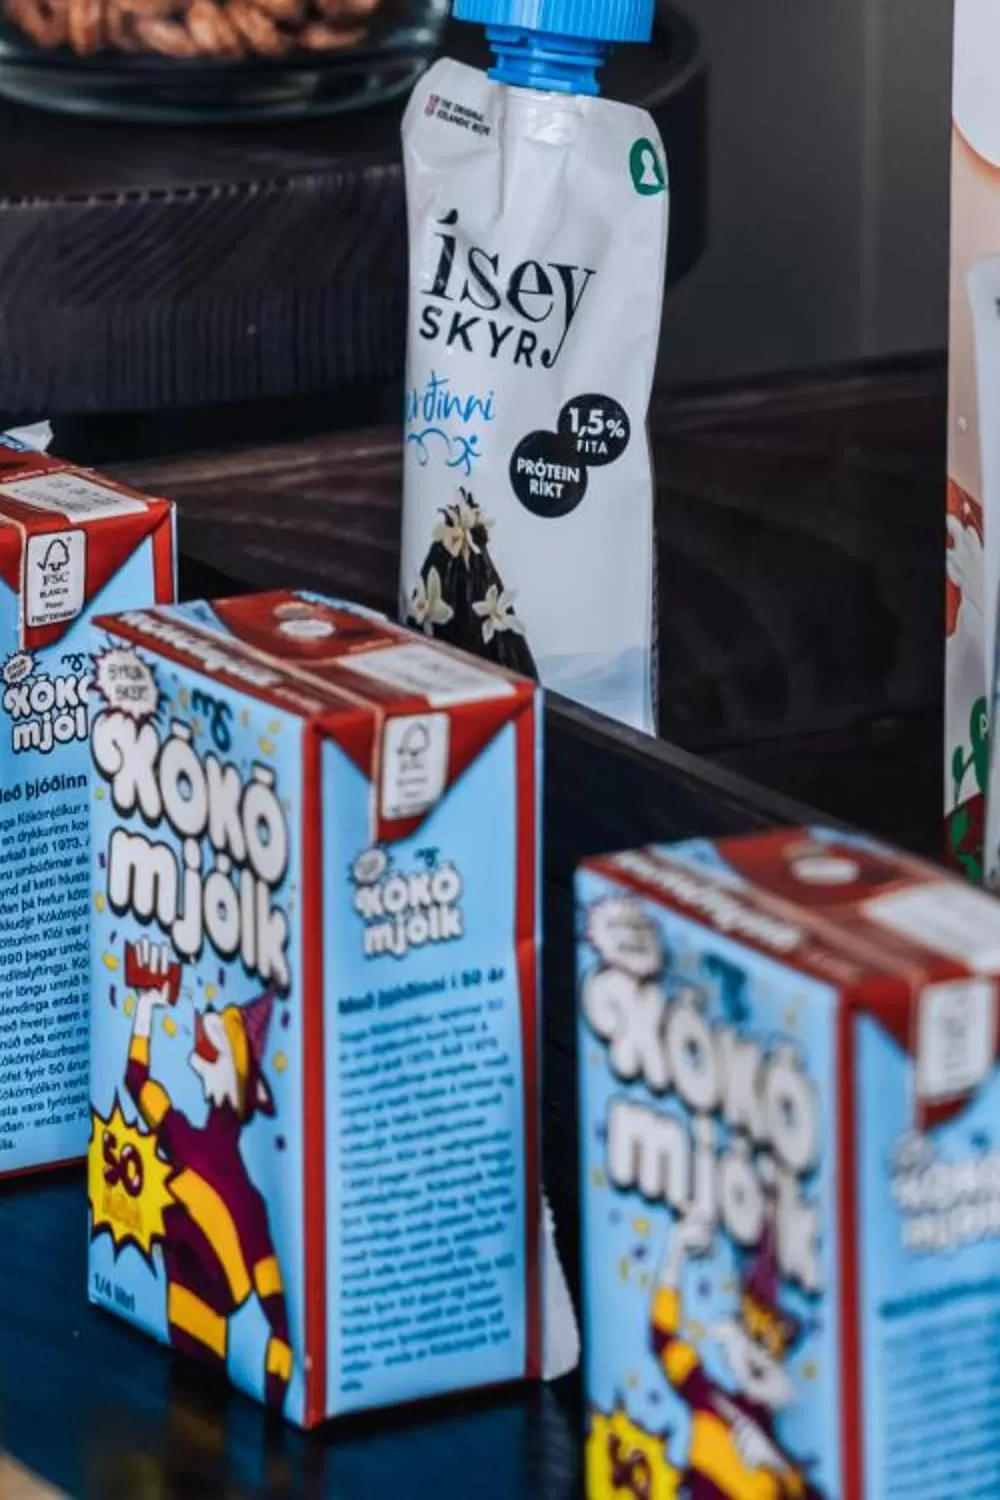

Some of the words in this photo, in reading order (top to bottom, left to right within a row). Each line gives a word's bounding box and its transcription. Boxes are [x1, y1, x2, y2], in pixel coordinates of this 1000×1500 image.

[419, 305, 538, 368] SKYR
[569, 407, 626, 439] 1,5%
[577, 439, 609, 454] FITA
[517, 456, 580, 483] PRÓTEIN
[529, 480, 565, 499] RÍKT
[11, 706, 88, 754] mjól
[25, 773, 88, 798] þjóðinn
[107, 827, 291, 999] mjólk
[606, 1097, 822, 1303] mjók
